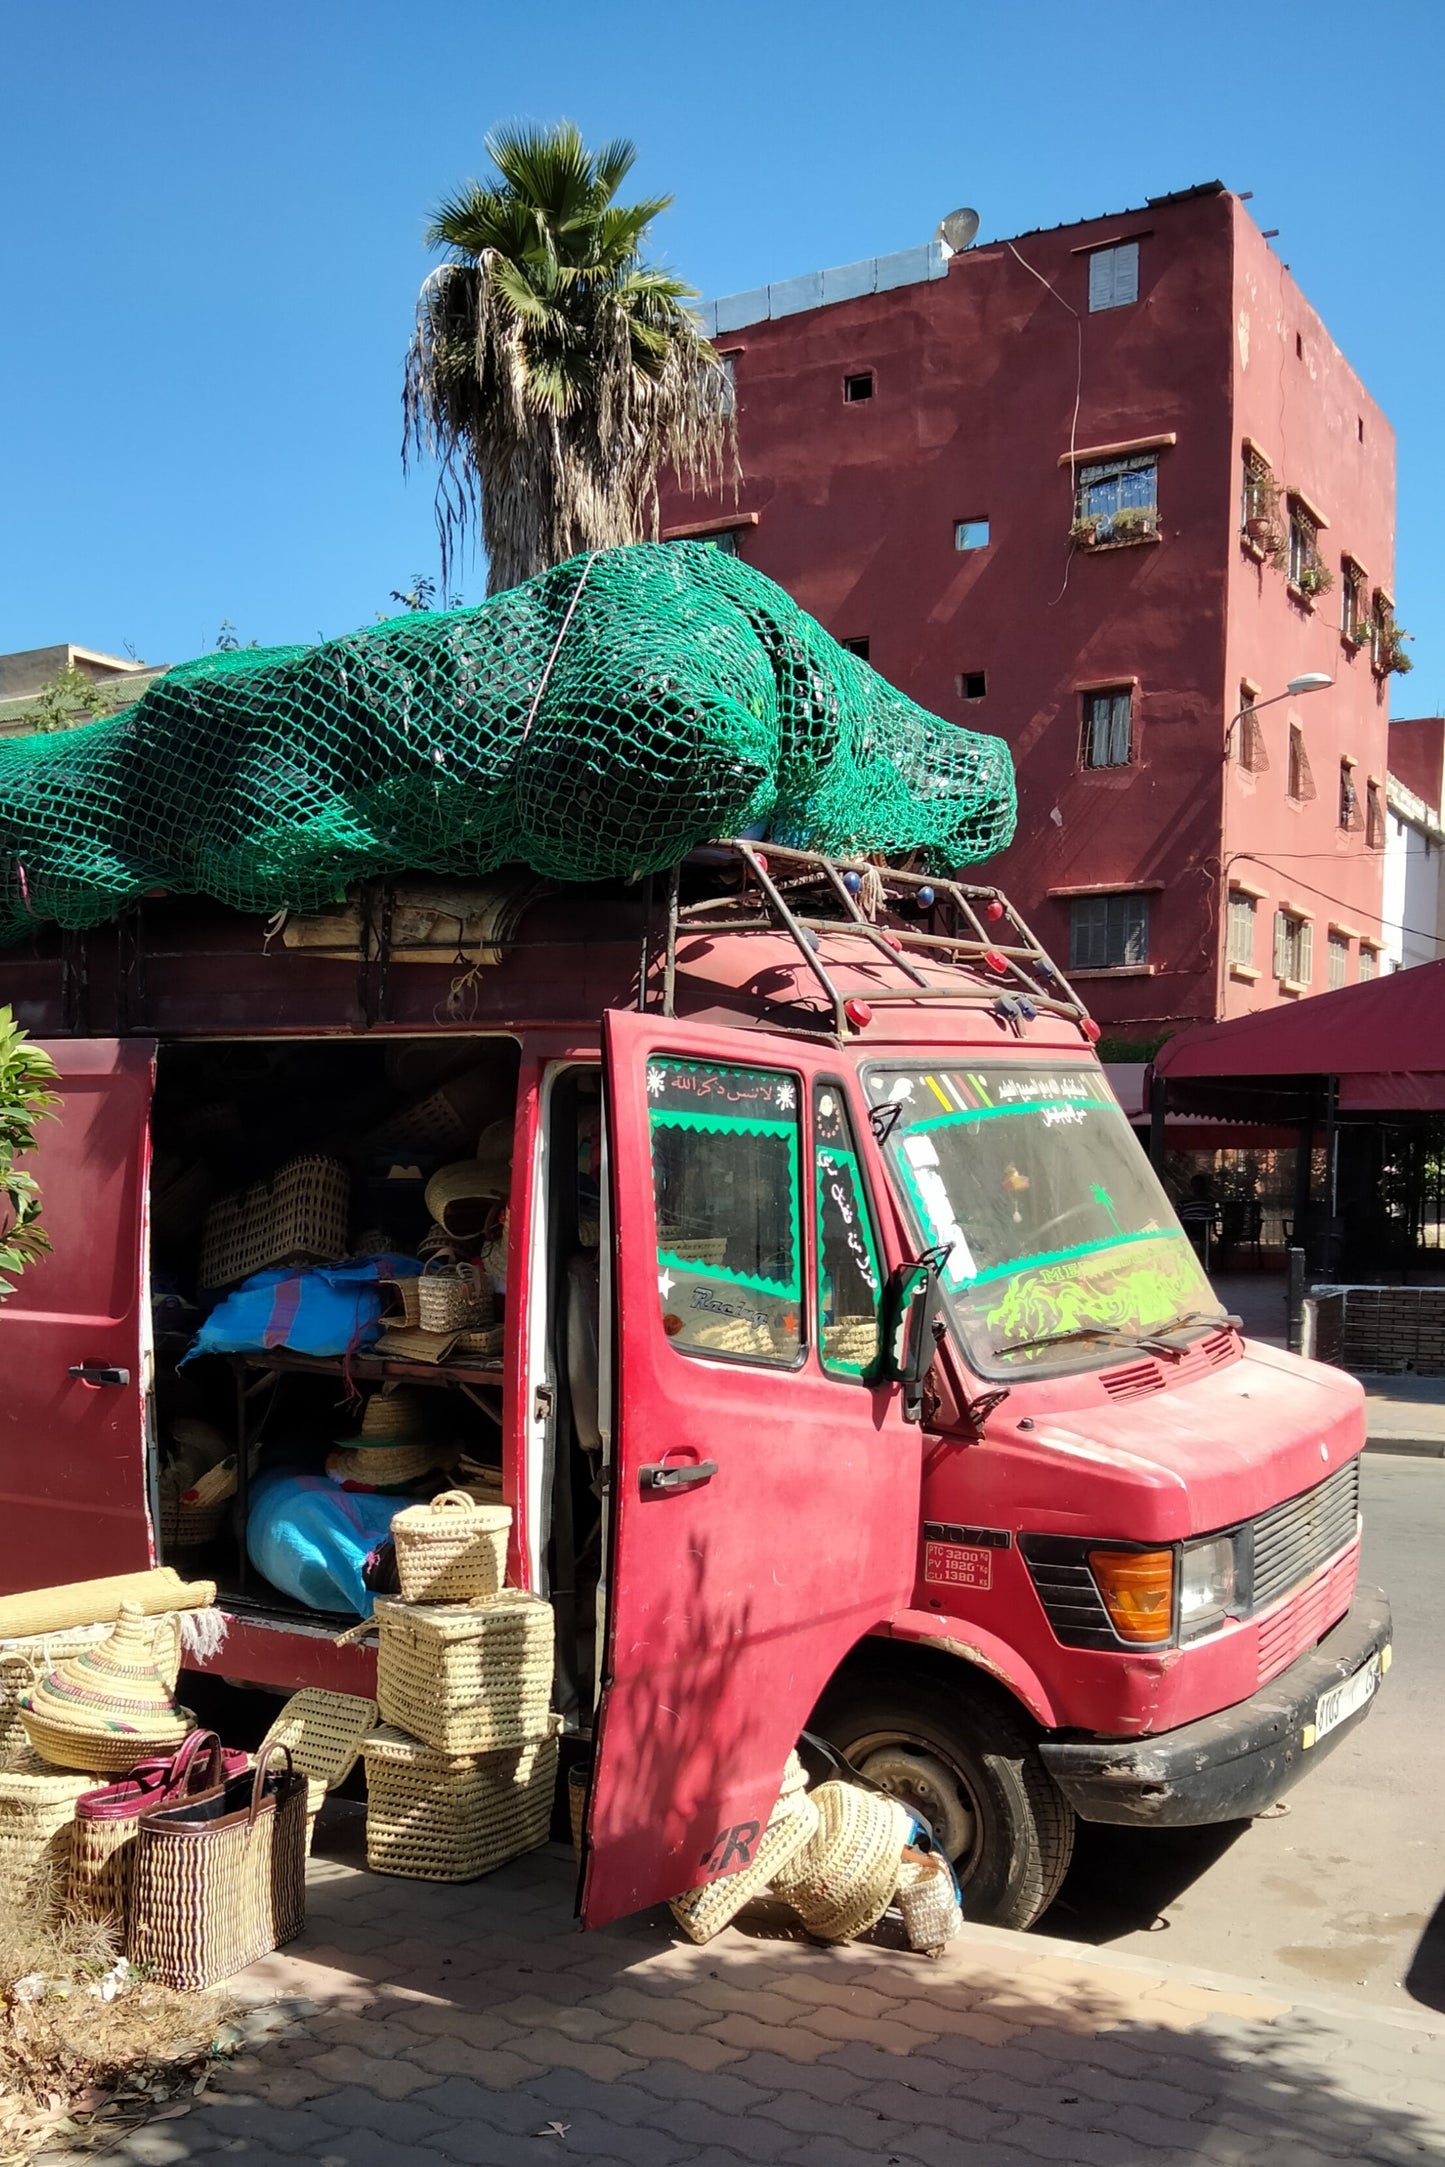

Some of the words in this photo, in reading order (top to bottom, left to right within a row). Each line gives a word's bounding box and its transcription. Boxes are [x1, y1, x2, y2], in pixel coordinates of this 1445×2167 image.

[671, 1075, 696, 1091] الله
[689, 1286, 769, 1330] Racing
[928, 1545, 944, 1556] PTC
[945, 1549, 979, 1562] 3200
[928, 1558, 942, 1568] PV
[945, 1570, 975, 1583] 1380
